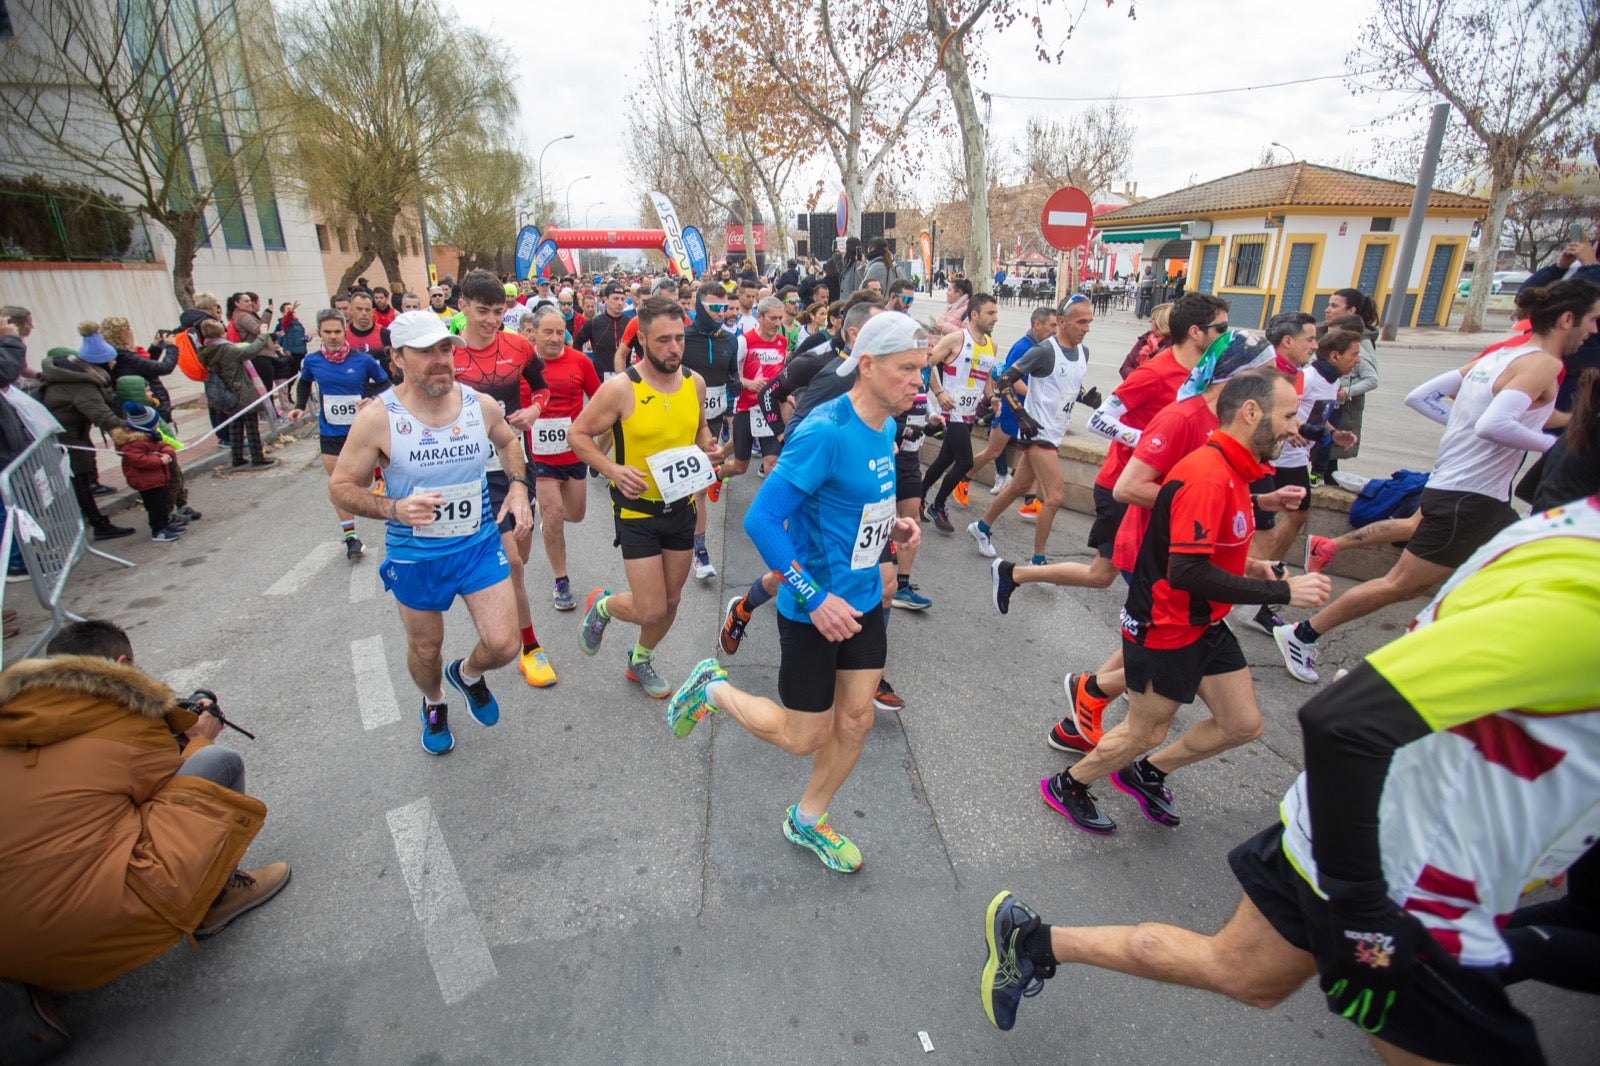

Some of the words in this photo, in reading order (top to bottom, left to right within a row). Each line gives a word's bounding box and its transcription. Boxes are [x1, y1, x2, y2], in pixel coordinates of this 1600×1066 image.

[959, 396, 977, 407] 397
[331, 404, 356, 416] 695
[539, 428, 566, 443] 569
[409, 442, 480, 462] MARACENA
[662, 456, 701, 483] 759
